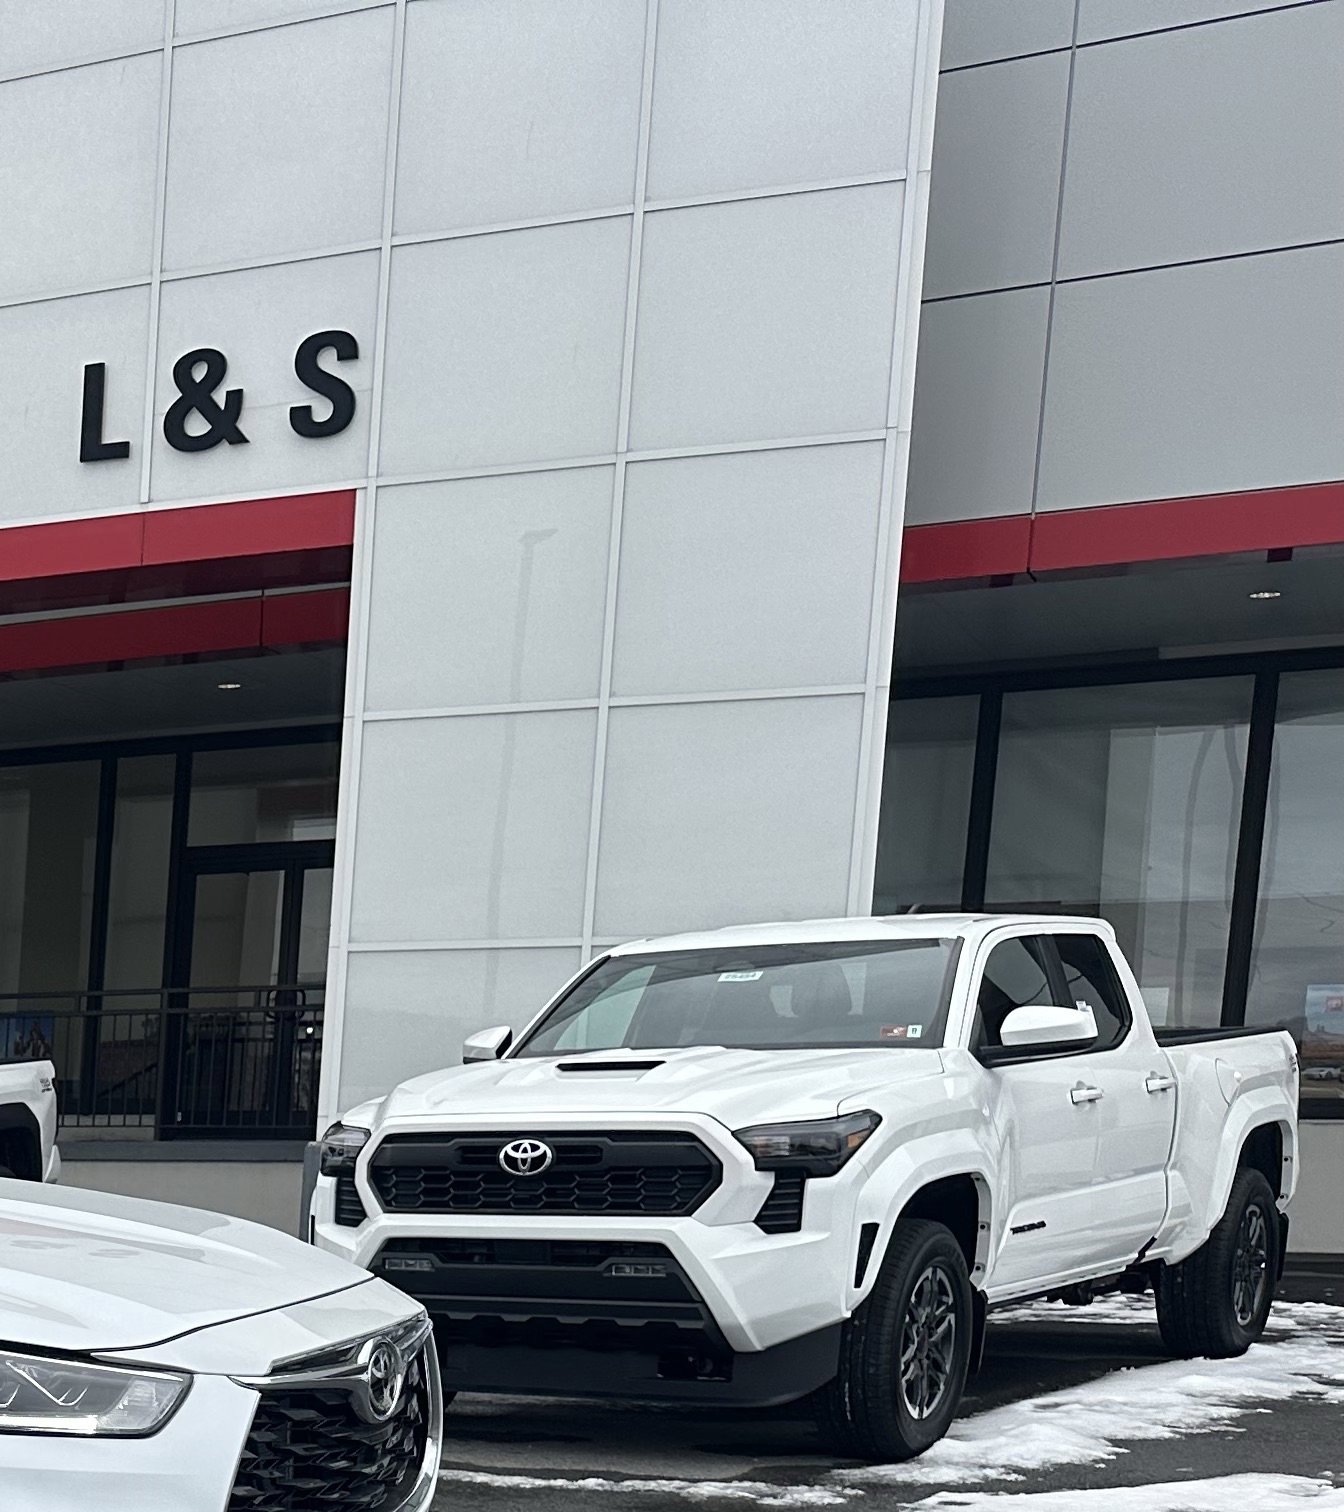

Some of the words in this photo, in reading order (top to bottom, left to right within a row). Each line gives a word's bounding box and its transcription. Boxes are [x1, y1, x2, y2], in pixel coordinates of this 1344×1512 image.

[80, 362, 130, 463] L
[163, 348, 250, 452] &
[289, 330, 359, 438] S
